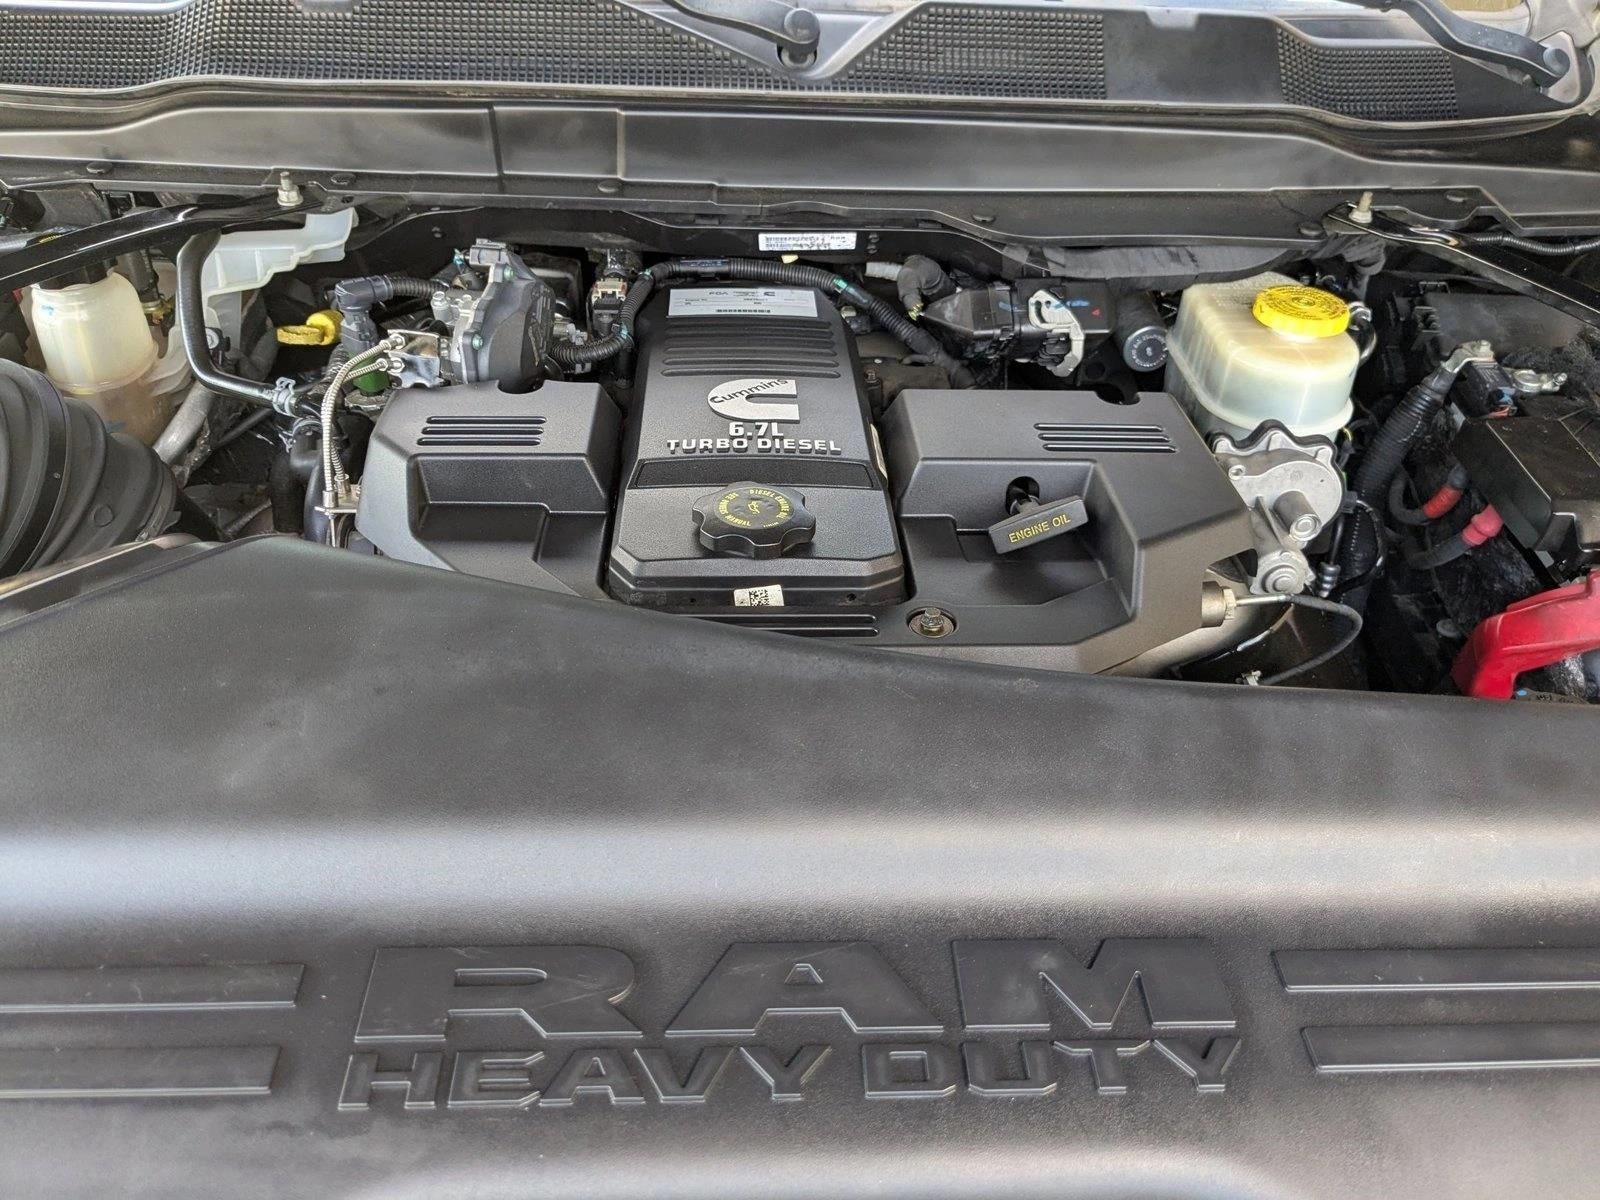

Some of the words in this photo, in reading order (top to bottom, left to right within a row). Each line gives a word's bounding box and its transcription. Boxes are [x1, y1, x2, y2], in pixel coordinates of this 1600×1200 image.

[710, 379, 789, 404] Cummins
[729, 422, 784, 438] 6.7L
[667, 438, 748, 451] TURBO
[757, 438, 842, 452] DIESEL
[749, 489, 775, 498] DIESEL
[774, 495, 790, 512] ENGINE
[724, 514, 752, 527] MANUAL
[1008, 521, 1050, 543] ENGINE
[1052, 514, 1071, 527] OIL
[354, 935, 1237, 1043] RAM
[336, 1044, 833, 1109] HEAVY
[859, 1035, 1242, 1099] DUTY
